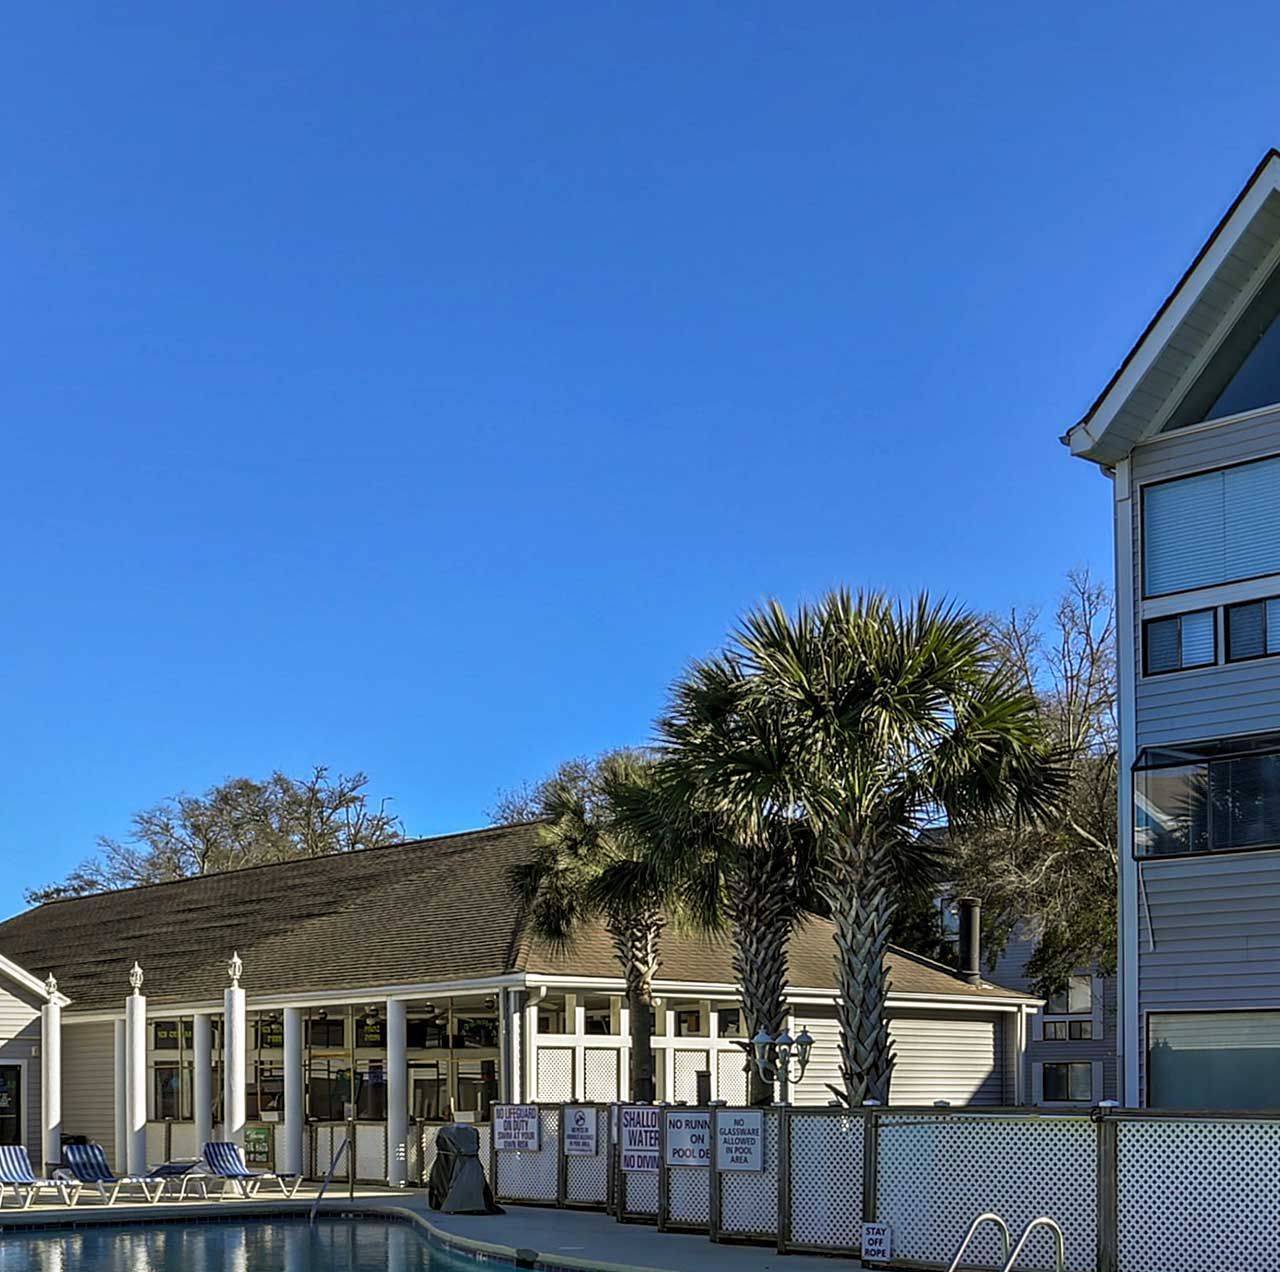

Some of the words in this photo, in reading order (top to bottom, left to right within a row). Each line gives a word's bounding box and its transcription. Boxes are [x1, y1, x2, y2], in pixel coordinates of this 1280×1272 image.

[623, 1111, 660, 1128] SHALLO
[669, 1119, 682, 1129] NO
[734, 1118, 744, 1126] NO
[719, 1128, 759, 1136] GLASSWARE
[690, 1134, 705, 1144] ON
[723, 1137, 756, 1145] ALLOWED
[672, 1148, 696, 1158] POOL
[735, 1147, 752, 1155] POOL
[624, 1155, 635, 1168] NO
[730, 1156, 748, 1164] AREA
[866, 1227, 887, 1236] STAY
[868, 1238, 883, 1247] OFF
[865, 1248, 887, 1257] ROPE
